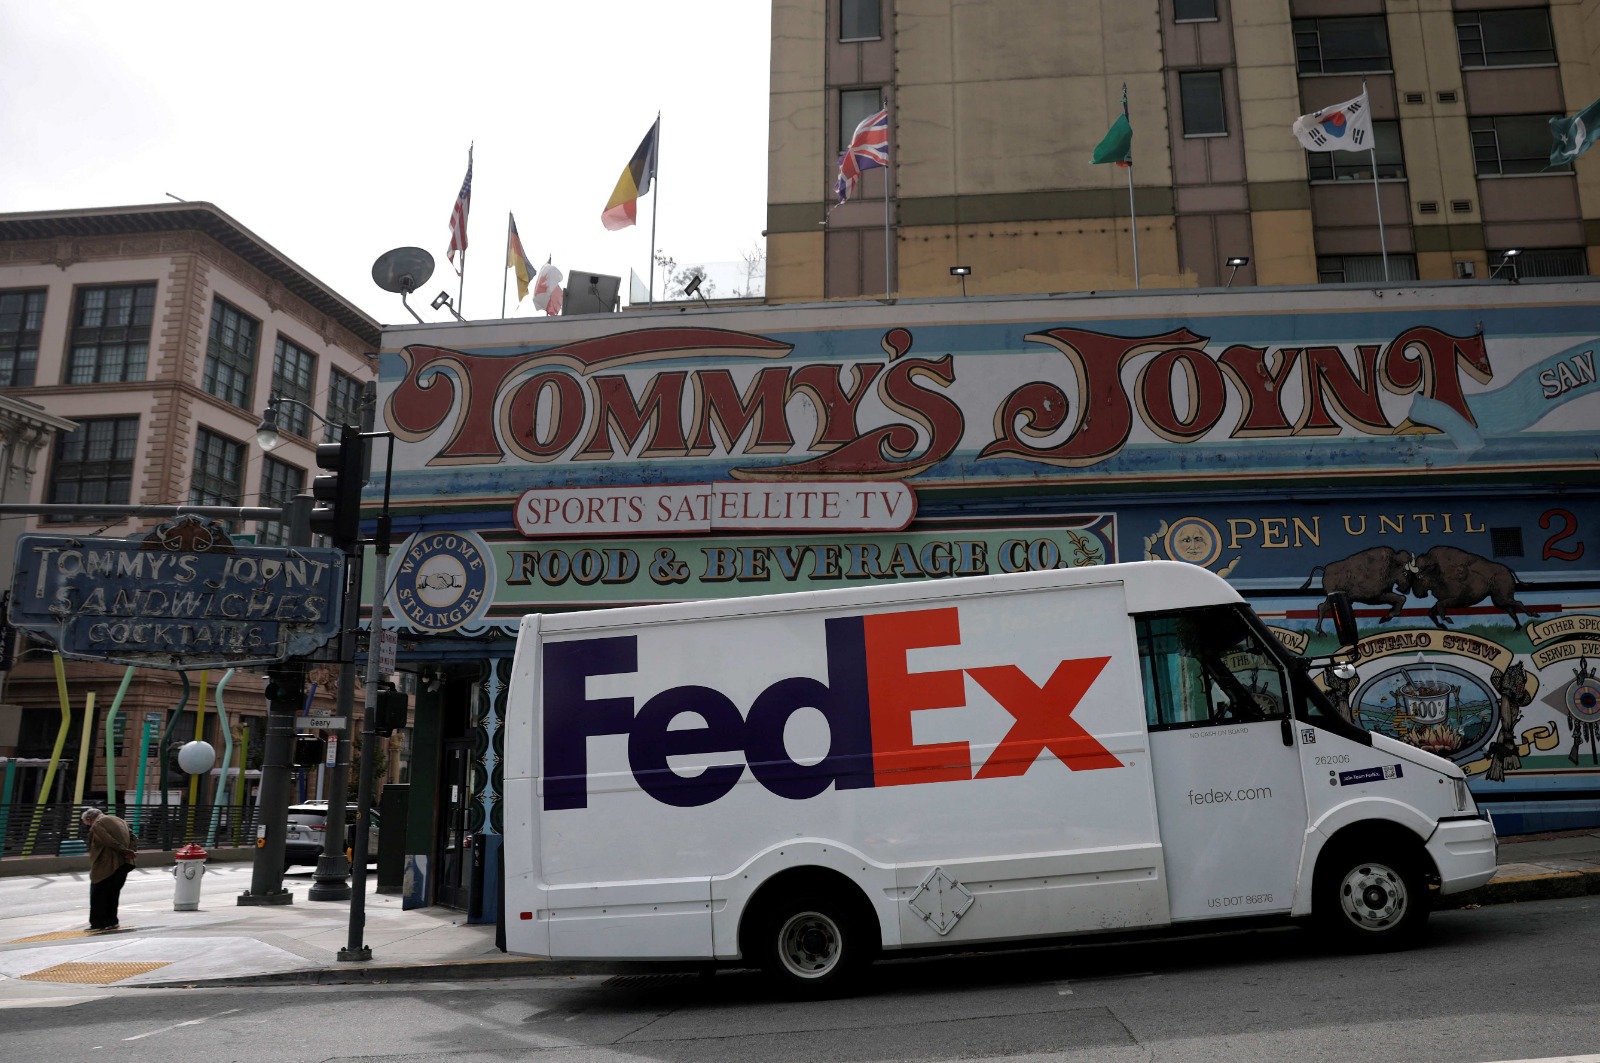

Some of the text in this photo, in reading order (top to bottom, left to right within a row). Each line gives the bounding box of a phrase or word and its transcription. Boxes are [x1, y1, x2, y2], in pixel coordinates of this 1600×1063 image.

[1539, 350, 1597, 399] SAN
[384, 325, 1493, 481] TOMMY'S JOYNT
[526, 490, 904, 525] SPORTS SATELLITE TV
[1341, 511, 1488, 537] UNTIL
[1538, 507, 1585, 562] 2
[31, 546, 200, 599] TOMMY'S
[400, 536, 483, 574] WELCOME
[506, 537, 1069, 585] FOOD & BEVERAGE CO.
[48, 586, 327, 622] SANDWICHES
[399, 588, 483, 627] STRANGER
[88, 622, 262, 648] COCKTAILS
[1542, 620, 1575, 636] OTHER
[1442, 634, 1502, 661] STEW
[1539, 644, 1576, 664] SERVED
[310, 719, 331, 729] Geary
[543, 606, 1125, 811] FedEx
[1411, 701, 1445, 718] 100%
[1315, 754, 1350, 766] 262006
[1187, 787, 1273, 806] fedex.com
[1207, 893, 1274, 908] US DOT 86876
